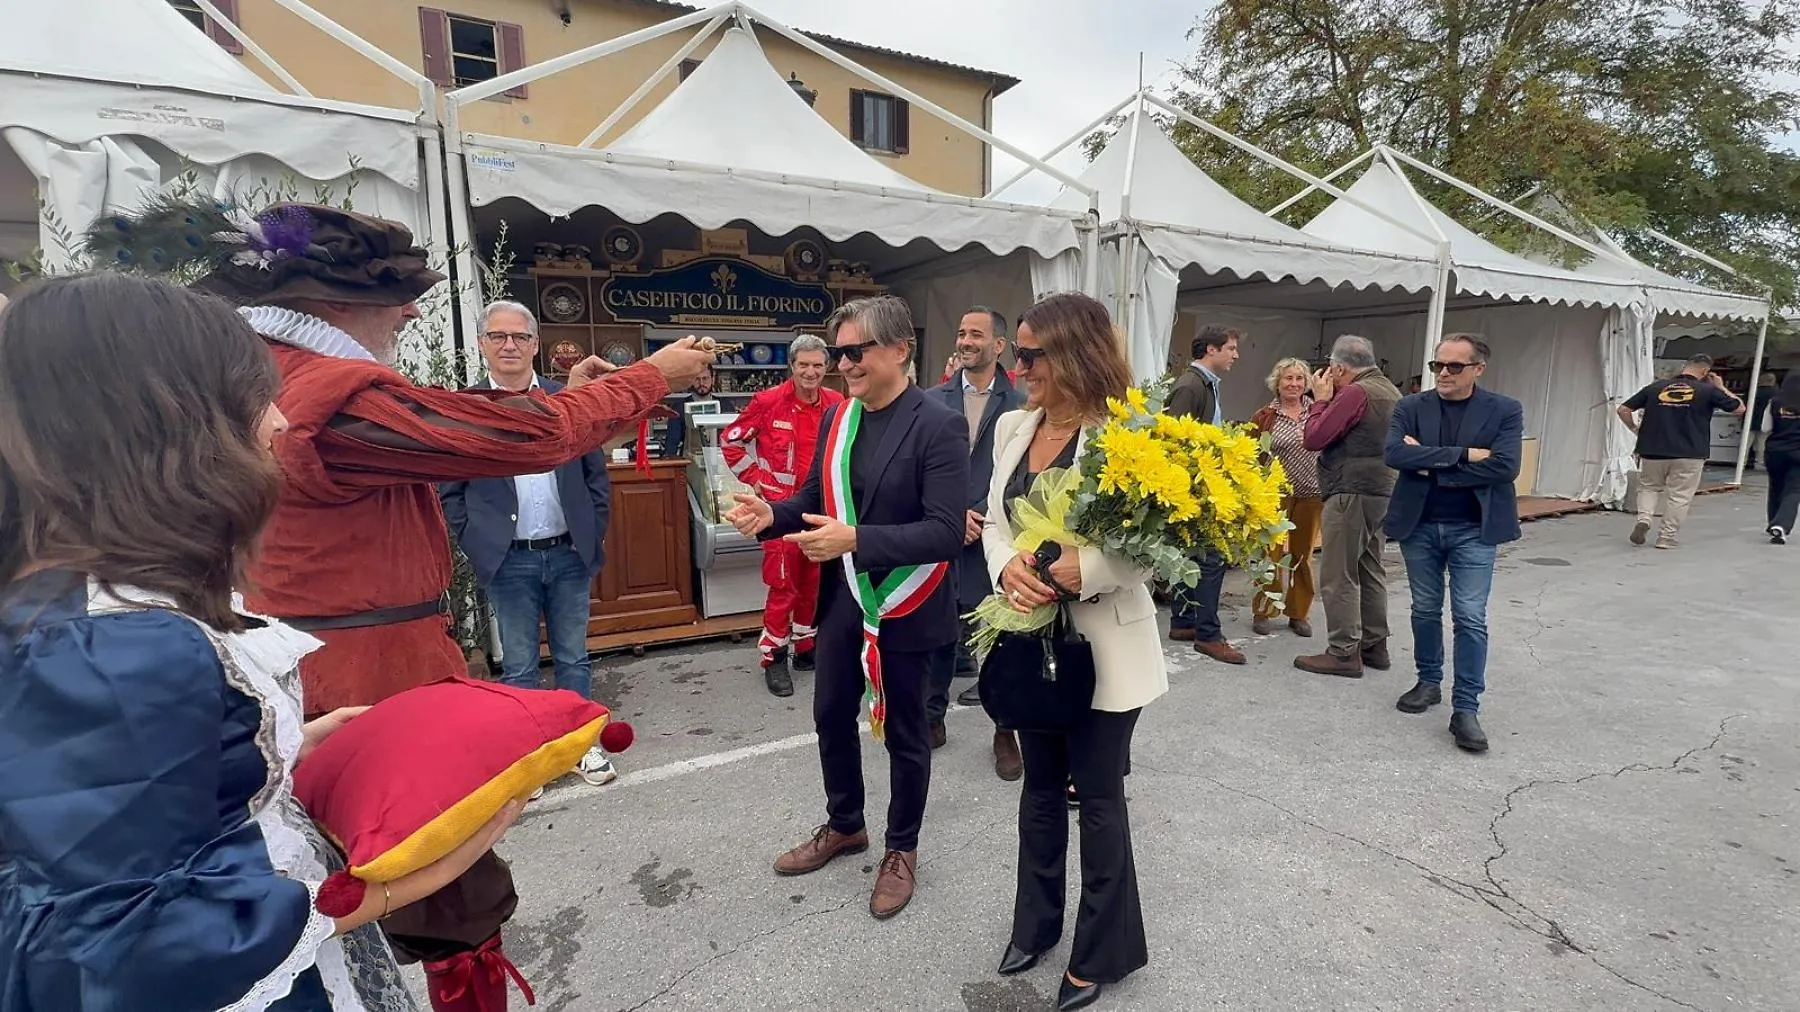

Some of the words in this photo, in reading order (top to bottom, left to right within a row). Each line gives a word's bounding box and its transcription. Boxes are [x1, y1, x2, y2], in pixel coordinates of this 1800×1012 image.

[608, 288, 722, 310] CASEIFICIO
[726, 294, 745, 311] IL
[747, 295, 824, 314] FIORINO
